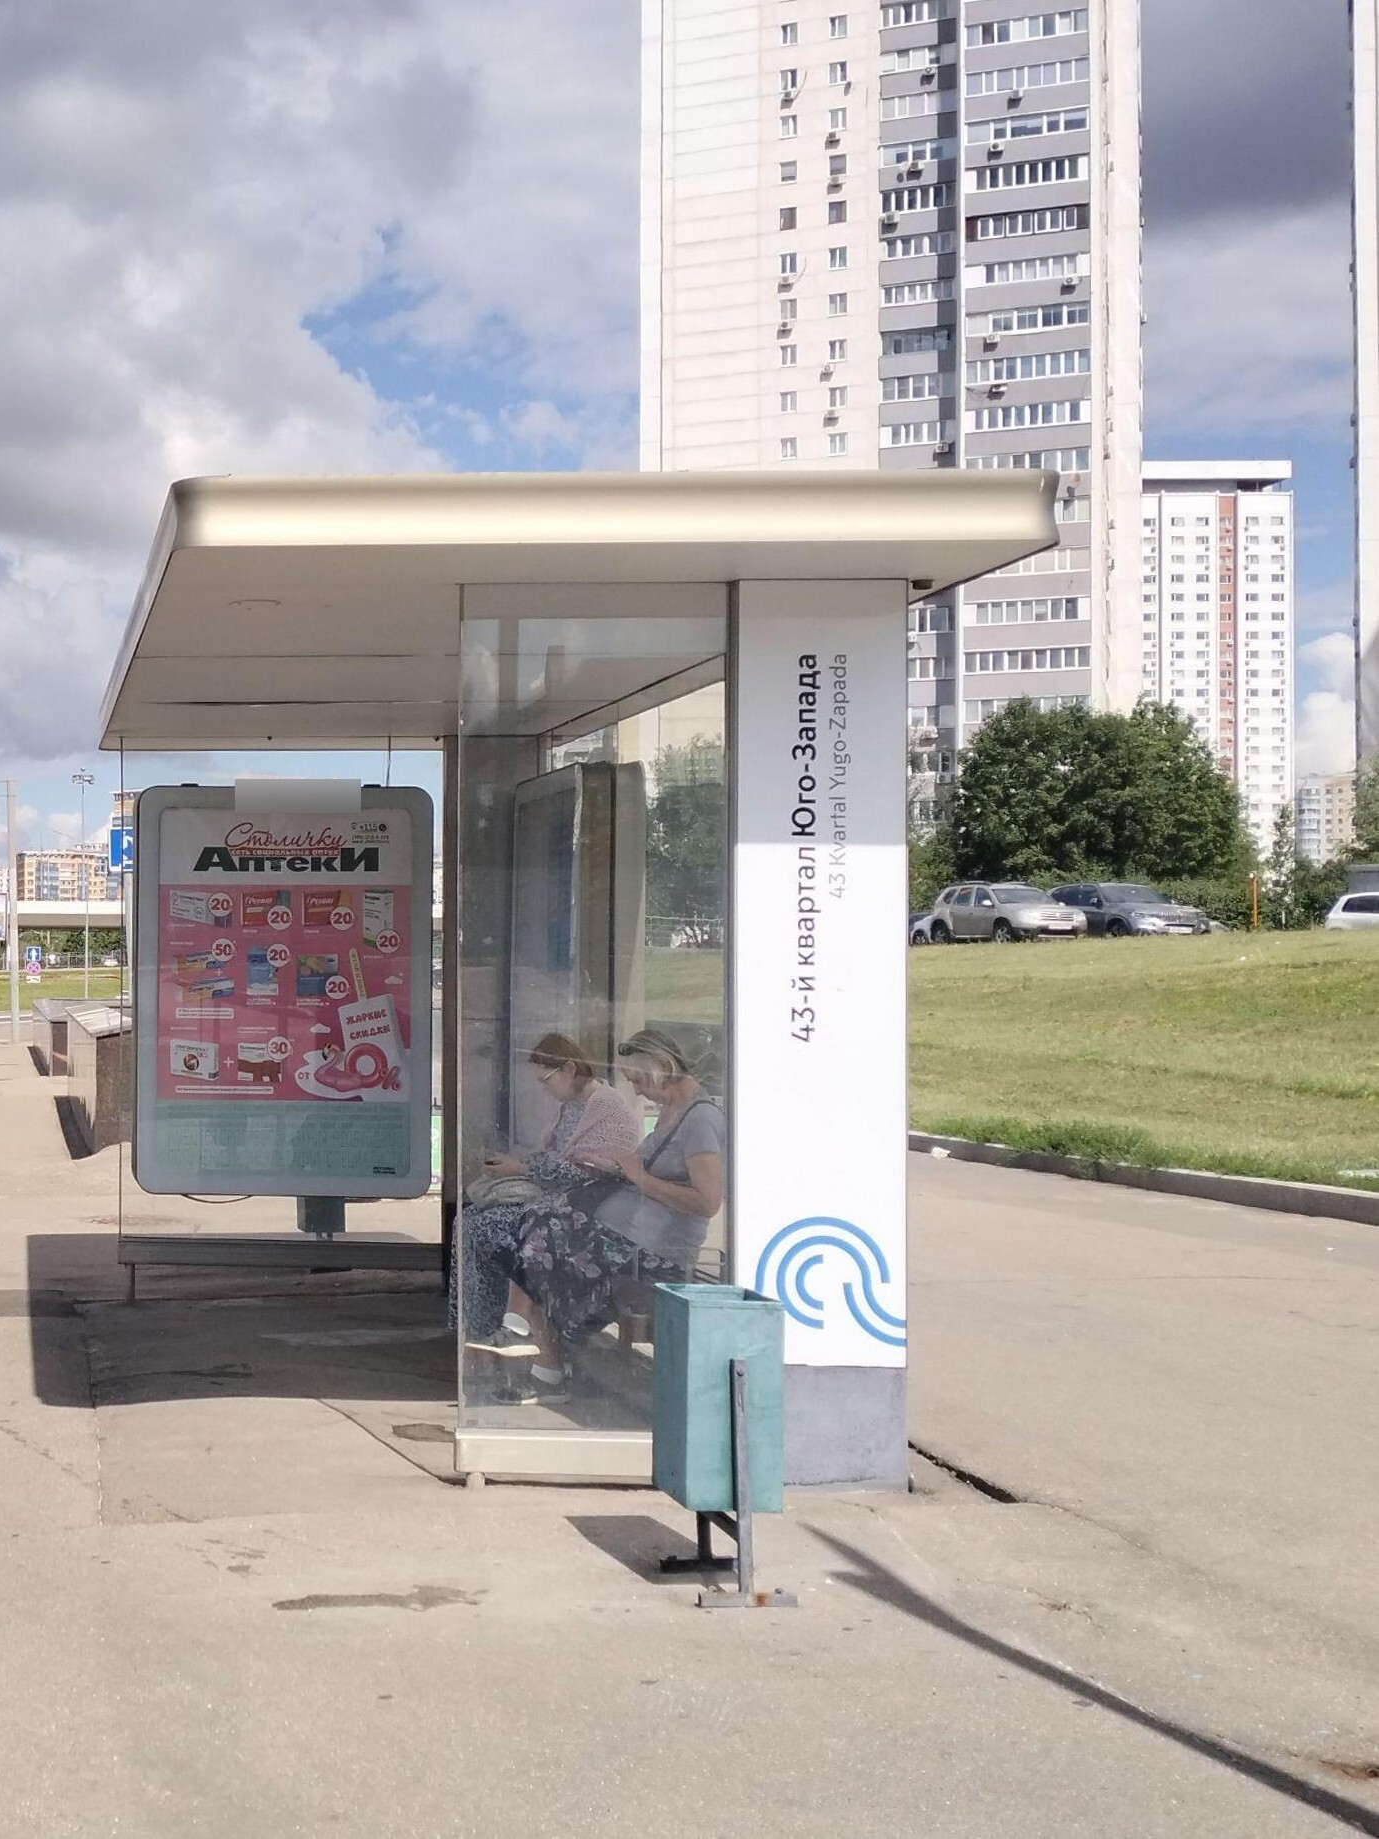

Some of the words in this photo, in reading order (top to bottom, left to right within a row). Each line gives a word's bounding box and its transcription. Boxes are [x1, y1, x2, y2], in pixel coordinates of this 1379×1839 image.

[791, 654, 821, 836] Юго-Запада
[828, 653, 851, 791] Yugo-Zapada
[828, 796, 847, 866] Kvartal
[797, 846, 821, 966] квартал
[828, 873, 847, 899] 43
[791, 975, 816, 1042] 43-й
